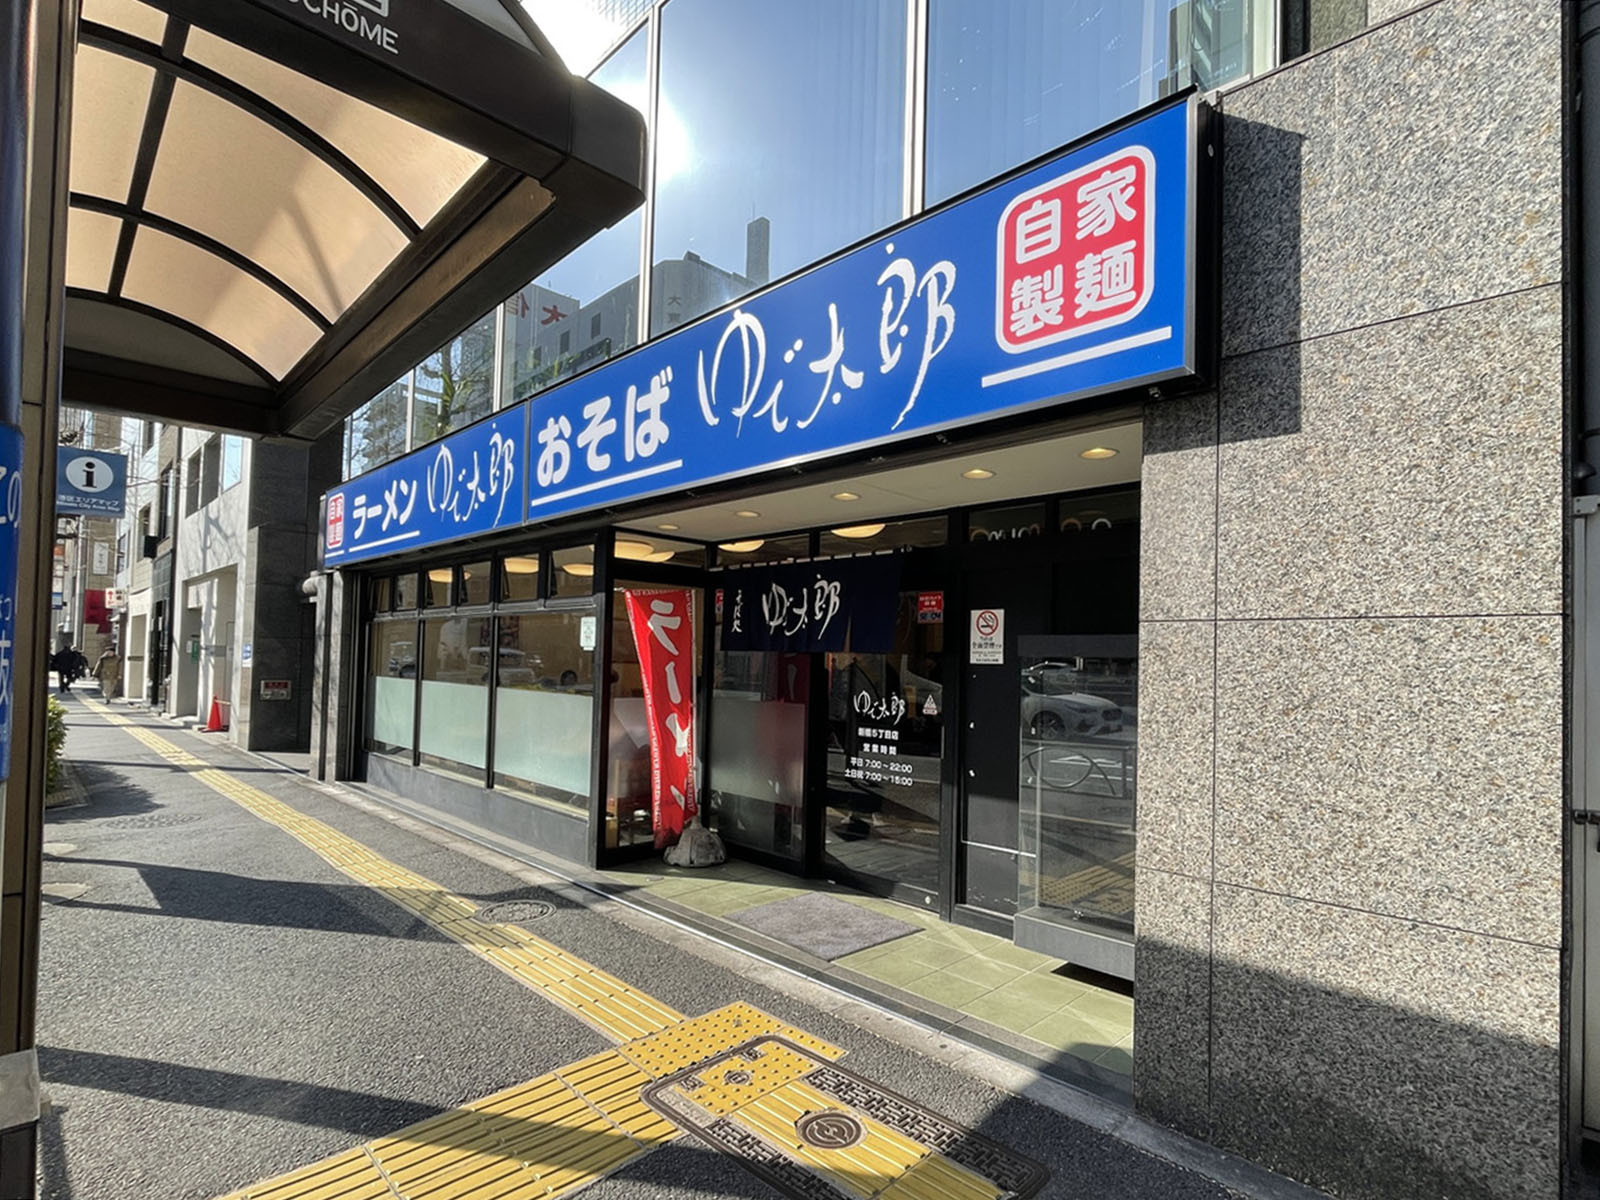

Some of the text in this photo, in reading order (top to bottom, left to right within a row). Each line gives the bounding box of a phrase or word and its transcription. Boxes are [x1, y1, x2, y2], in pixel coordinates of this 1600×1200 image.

[1015, 165, 1137, 264] 自家
[1010, 239, 1137, 338] 製麺
[537, 365, 674, 488] おそば
[352, 479, 418, 540] ラーメン
